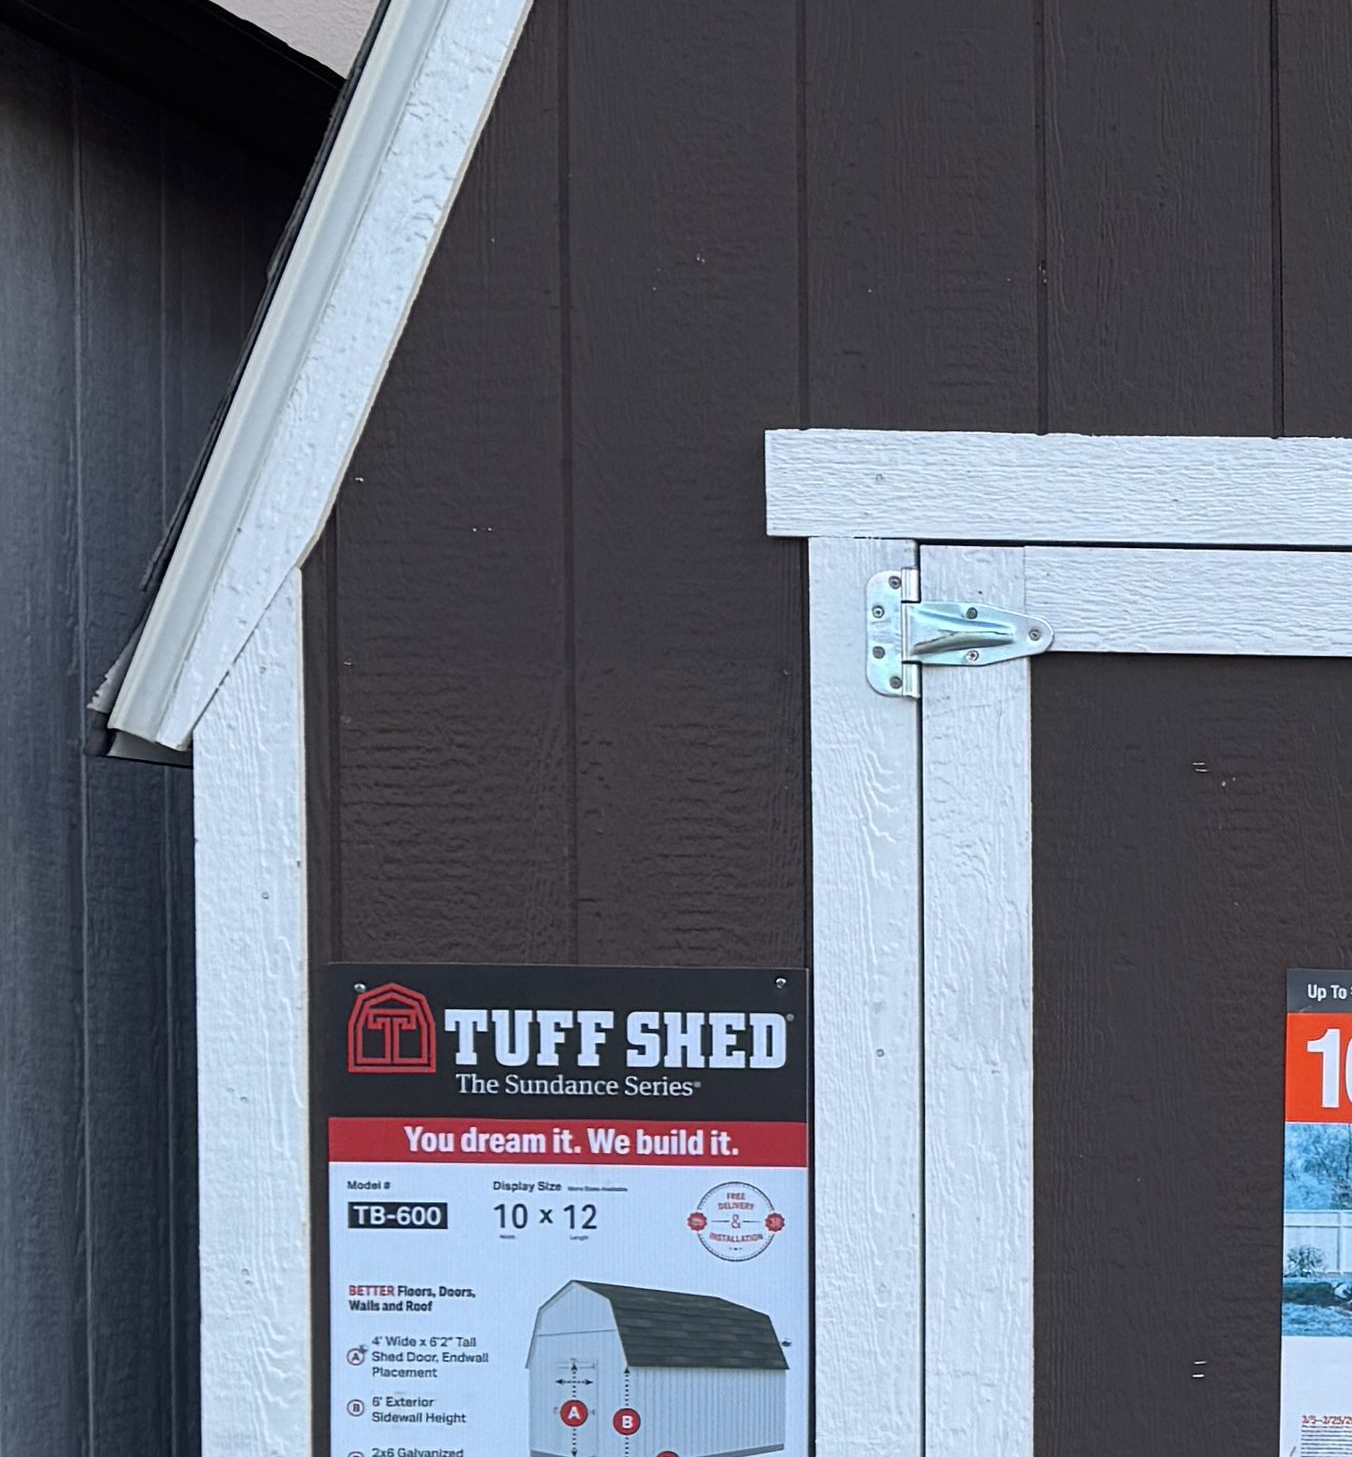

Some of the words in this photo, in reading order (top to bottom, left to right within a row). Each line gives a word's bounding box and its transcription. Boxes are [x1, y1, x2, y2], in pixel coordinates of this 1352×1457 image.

[1307, 983, 1327, 1002] Up
[1331, 984, 1347, 1000] To
[444, 1008, 615, 1067] TUFF
[626, 1011, 788, 1070] SHED
[456, 1073, 499, 1095] The
[505, 1074, 619, 1097] Sundance
[404, 1125, 455, 1153] You
[461, 1127, 547, 1154] dream
[553, 1128, 582, 1155] it.
[587, 1129, 631, 1155] We
[636, 1130, 704, 1156] build
[711, 1131, 739, 1156] it.
[347, 1180, 382, 1190] Model
[383, 1181, 391, 1190] #
[493, 1181, 535, 1193] Display
[537, 1181, 562, 1191] Size
[353, 1205, 442, 1226] TB-600
[493, 1203, 529, 1229] 10
[539, 1208, 553, 1224] x
[563, 1203, 598, 1230] 12
[348, 1284, 395, 1297] BETTER
[397, 1285, 436, 1298] Floors,
[438, 1286, 476, 1298] Doors,
[348, 1299, 380, 1312] Walls
[382, 1300, 403, 1312] and
[405, 1300, 433, 1312] Roof
[385, 1336, 417, 1347] Wide
[419, 1339, 427, 1347] x
[455, 1337, 477, 1348] Tall
[371, 1351, 403, 1363] Shed
[406, 1351, 439, 1363] Door,
[442, 1352, 490, 1363] Endwall
[371, 1366, 438, 1378] Placement
[385, 1396, 435, 1408] Exterior
[371, 1412, 423, 1423] Sidewall
[425, 1412, 467, 1426] Height
